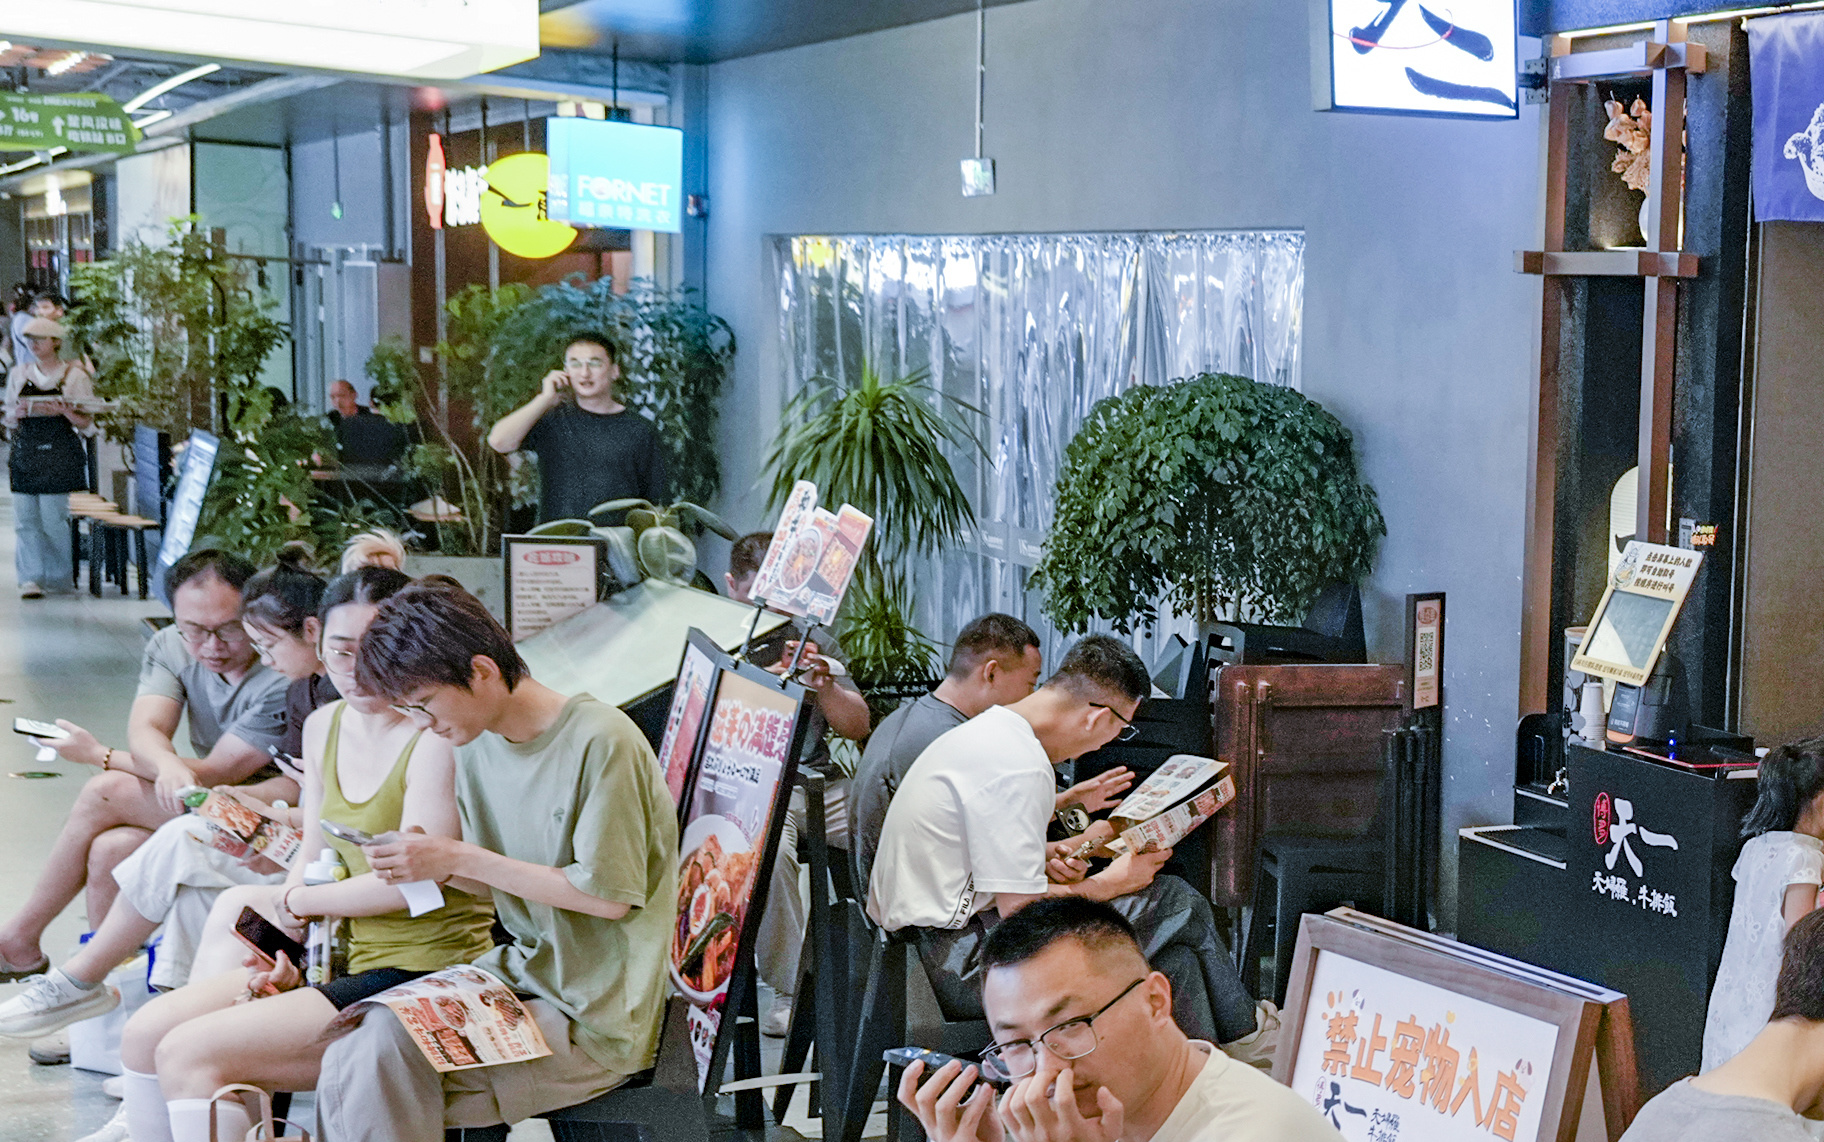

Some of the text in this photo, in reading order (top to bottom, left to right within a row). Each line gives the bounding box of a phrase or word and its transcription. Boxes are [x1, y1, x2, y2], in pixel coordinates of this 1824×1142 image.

[577, 175, 673, 206] FORNET
[1605, 797, 1679, 878] 天一
[960, 897, 971, 915] FILA
[1321, 1010, 1527, 1142] 禁止宠物入店
